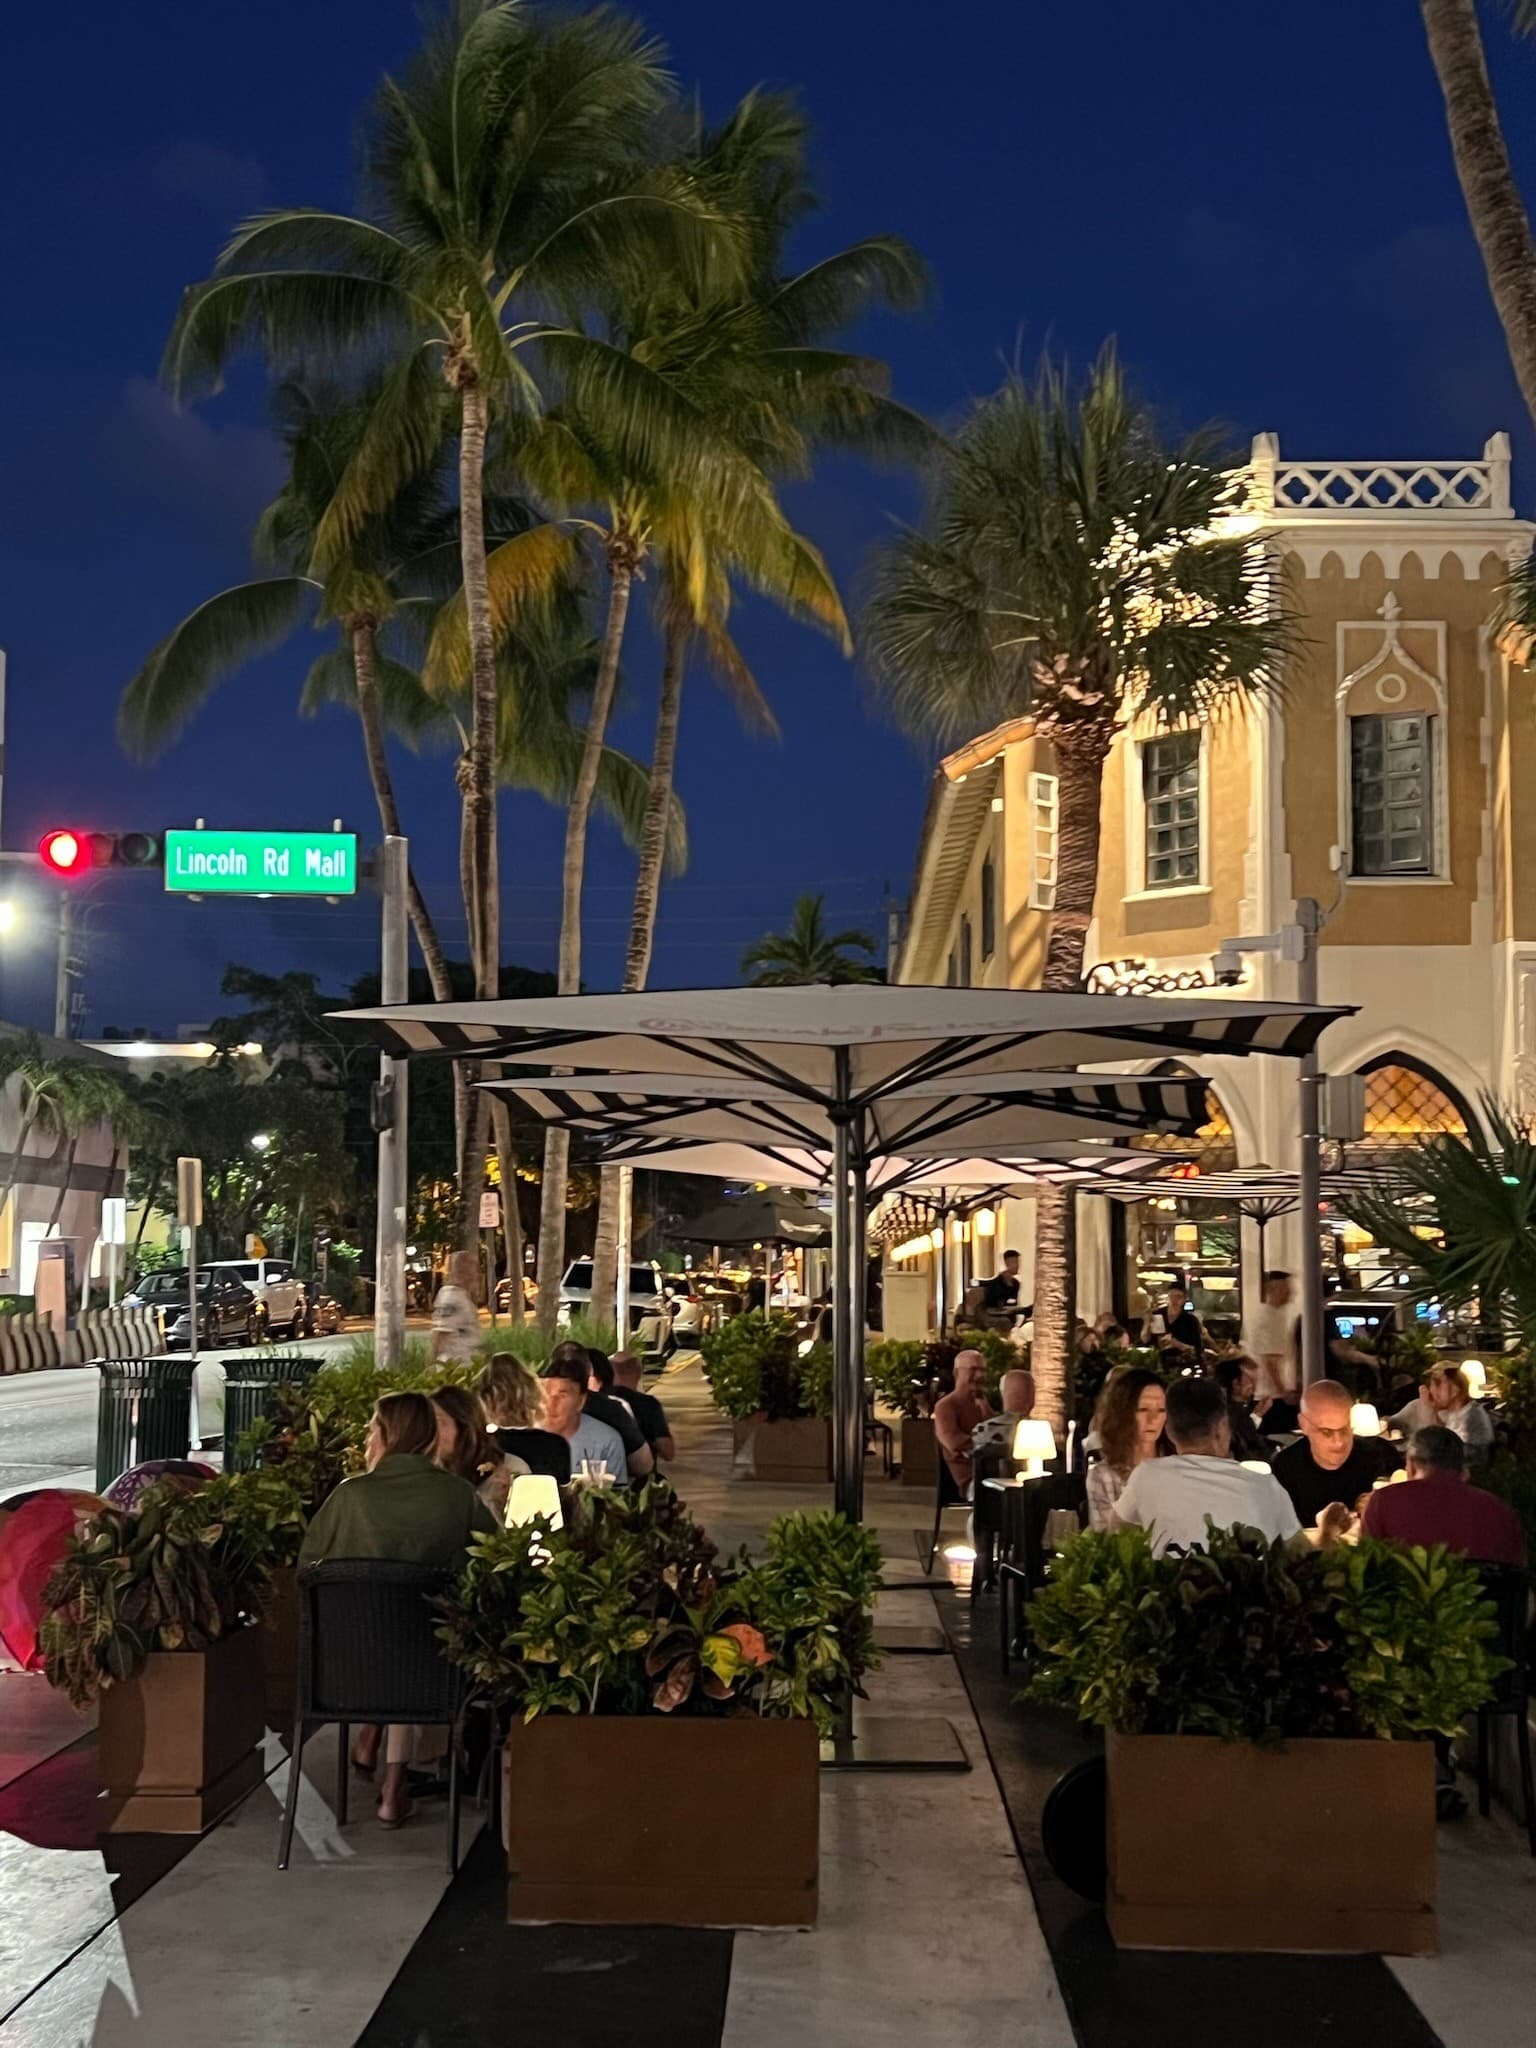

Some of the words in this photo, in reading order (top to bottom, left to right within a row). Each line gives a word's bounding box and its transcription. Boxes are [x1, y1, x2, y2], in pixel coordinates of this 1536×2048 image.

[176, 846, 247, 875] Lincoln
[263, 847, 289, 876] Rd
[305, 848, 346, 877] Mall
